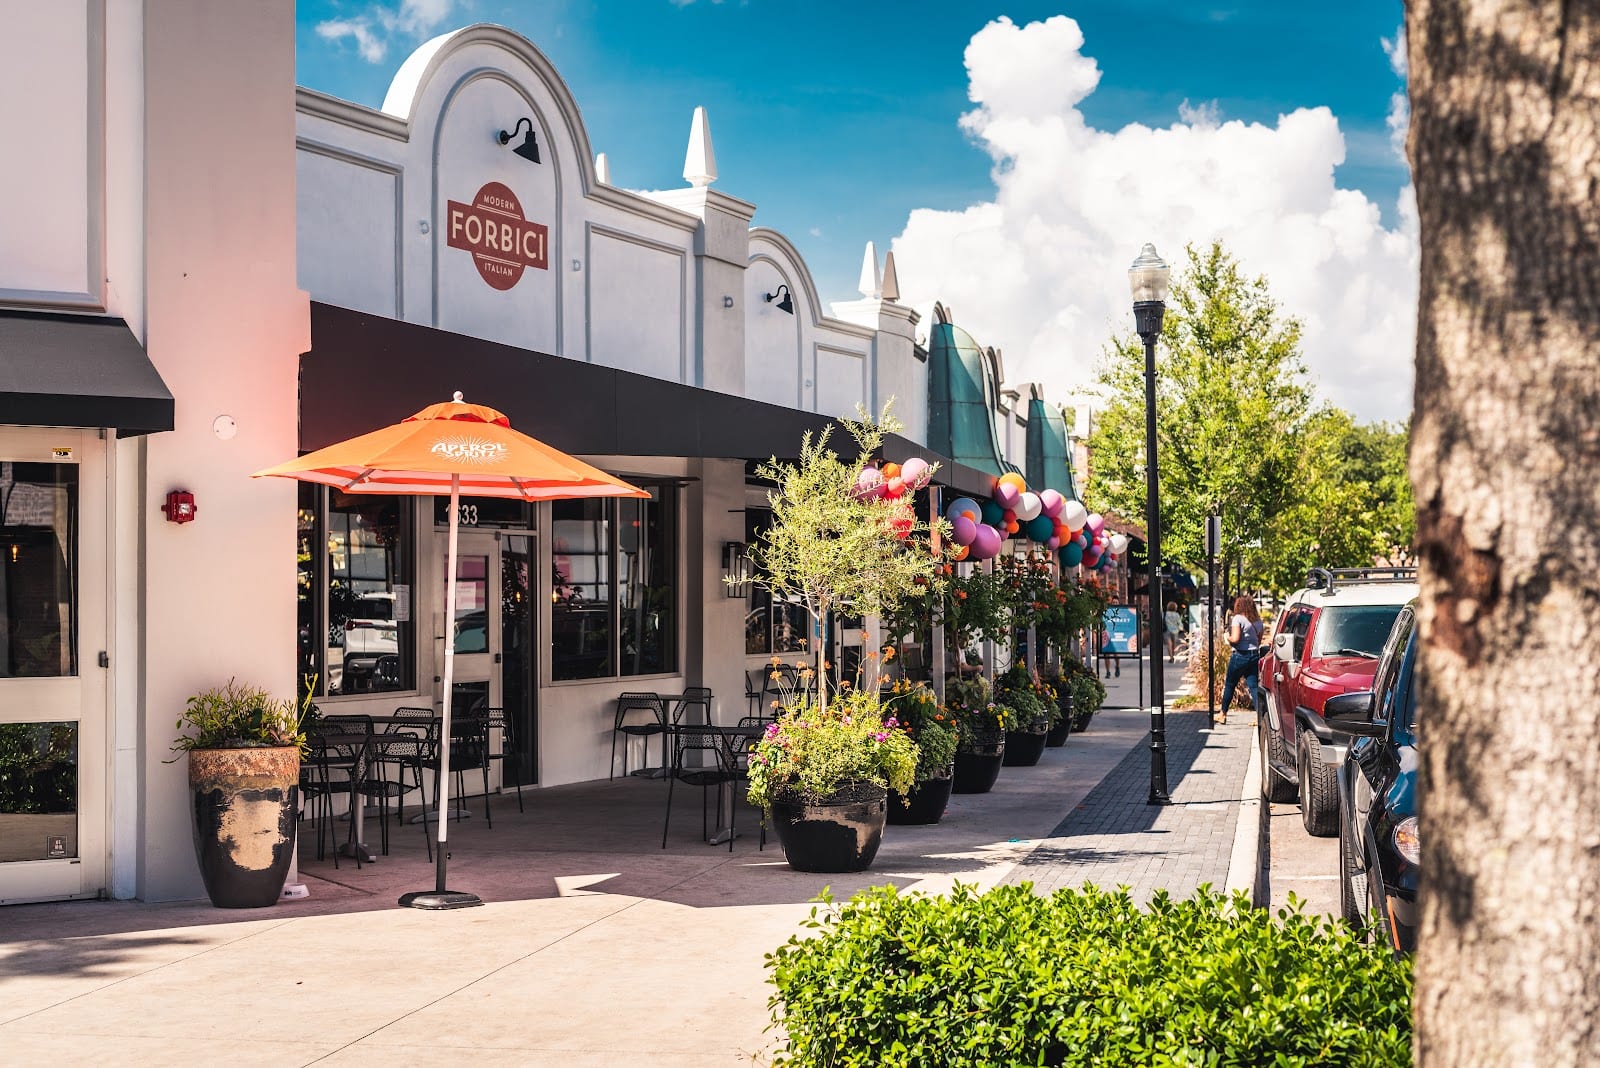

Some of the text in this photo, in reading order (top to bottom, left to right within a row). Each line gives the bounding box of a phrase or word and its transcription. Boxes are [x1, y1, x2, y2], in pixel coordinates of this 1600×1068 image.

[484, 195, 514, 210] MODERN
[452, 210, 543, 261] FORBICI
[485, 263, 512, 276] ITALIAN
[431, 442, 508, 453] APEROL
